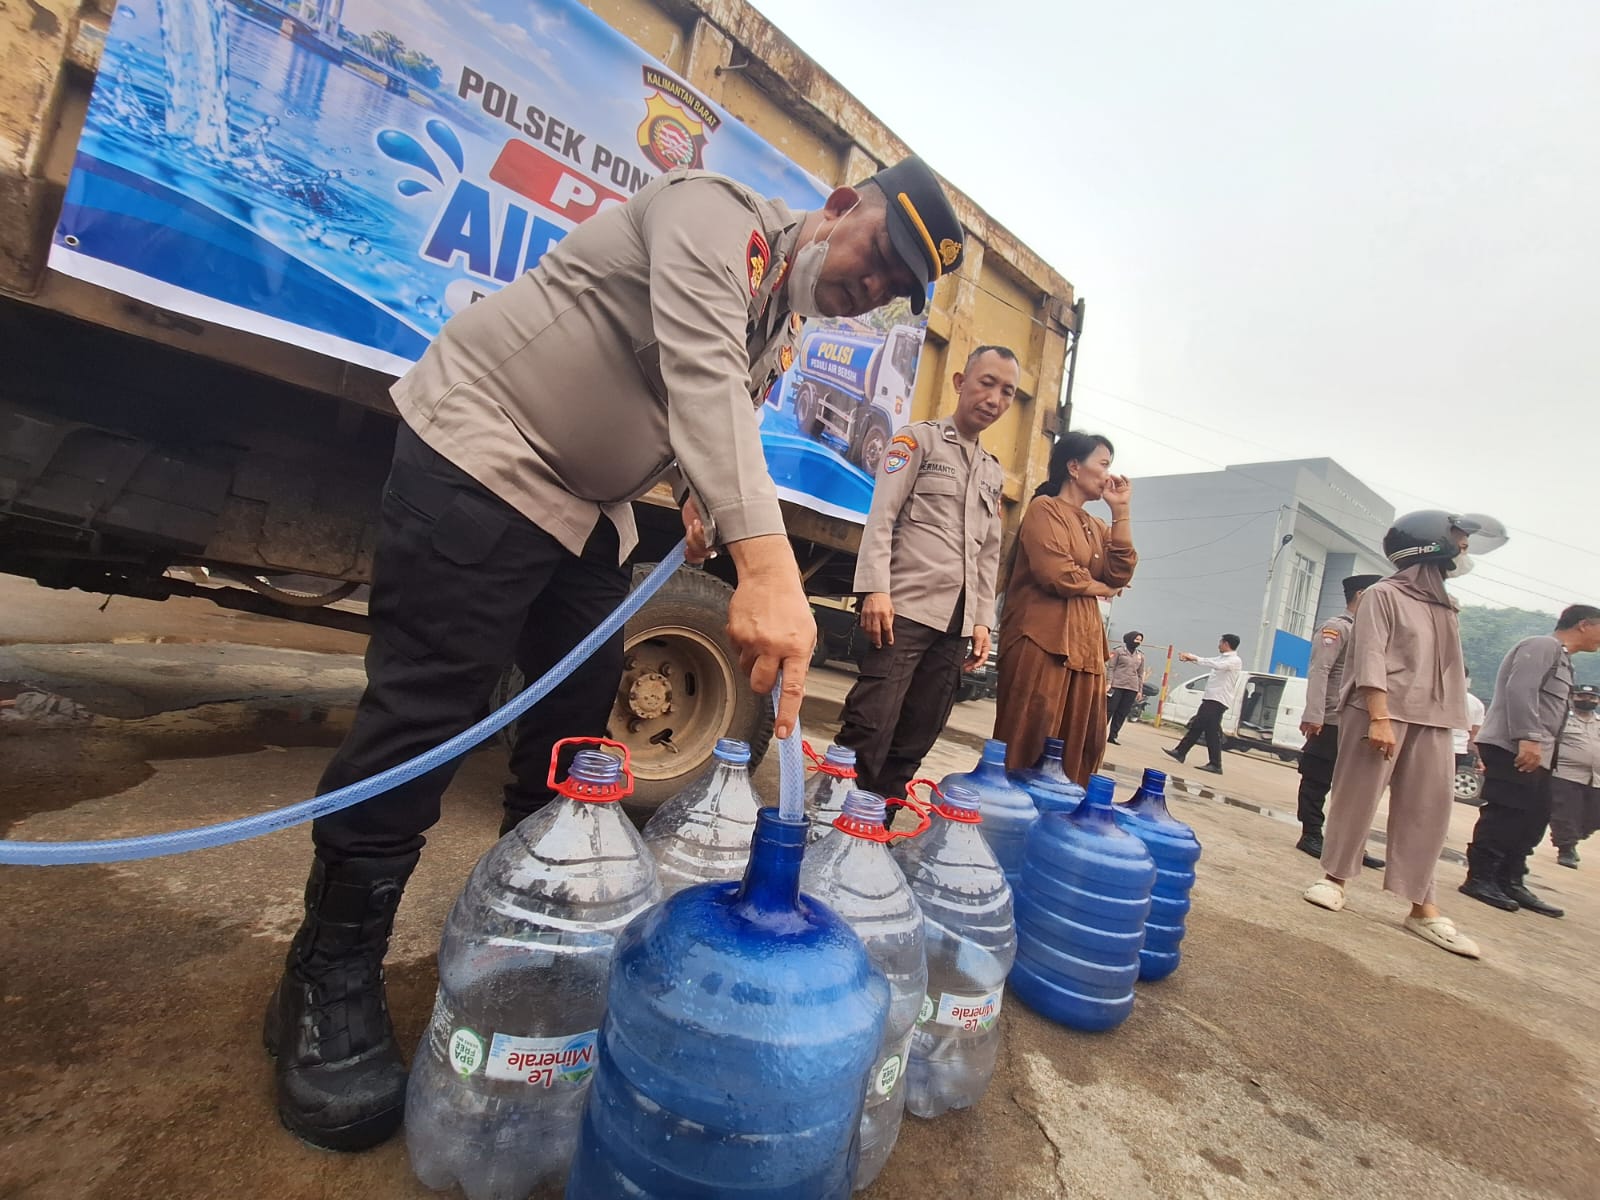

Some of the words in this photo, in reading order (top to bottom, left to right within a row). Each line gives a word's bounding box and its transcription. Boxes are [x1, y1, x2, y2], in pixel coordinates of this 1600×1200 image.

[647, 71, 695, 107] KALIMANTAN
[693, 101, 718, 127] BARAT
[457, 65, 587, 165] POLSEK
[817, 341, 855, 366] POLISI
[810, 358, 829, 373] PEDULI
[828, 362, 838, 375] AIR
[951, 1002, 995, 1020] Minerale
[964, 1019, 978, 1032] Le
[454, 1050, 475, 1067] BPA
[455, 1040, 477, 1058] FREE
[508, 1044, 594, 1071] Minerale
[527, 1068, 553, 1088] Le
